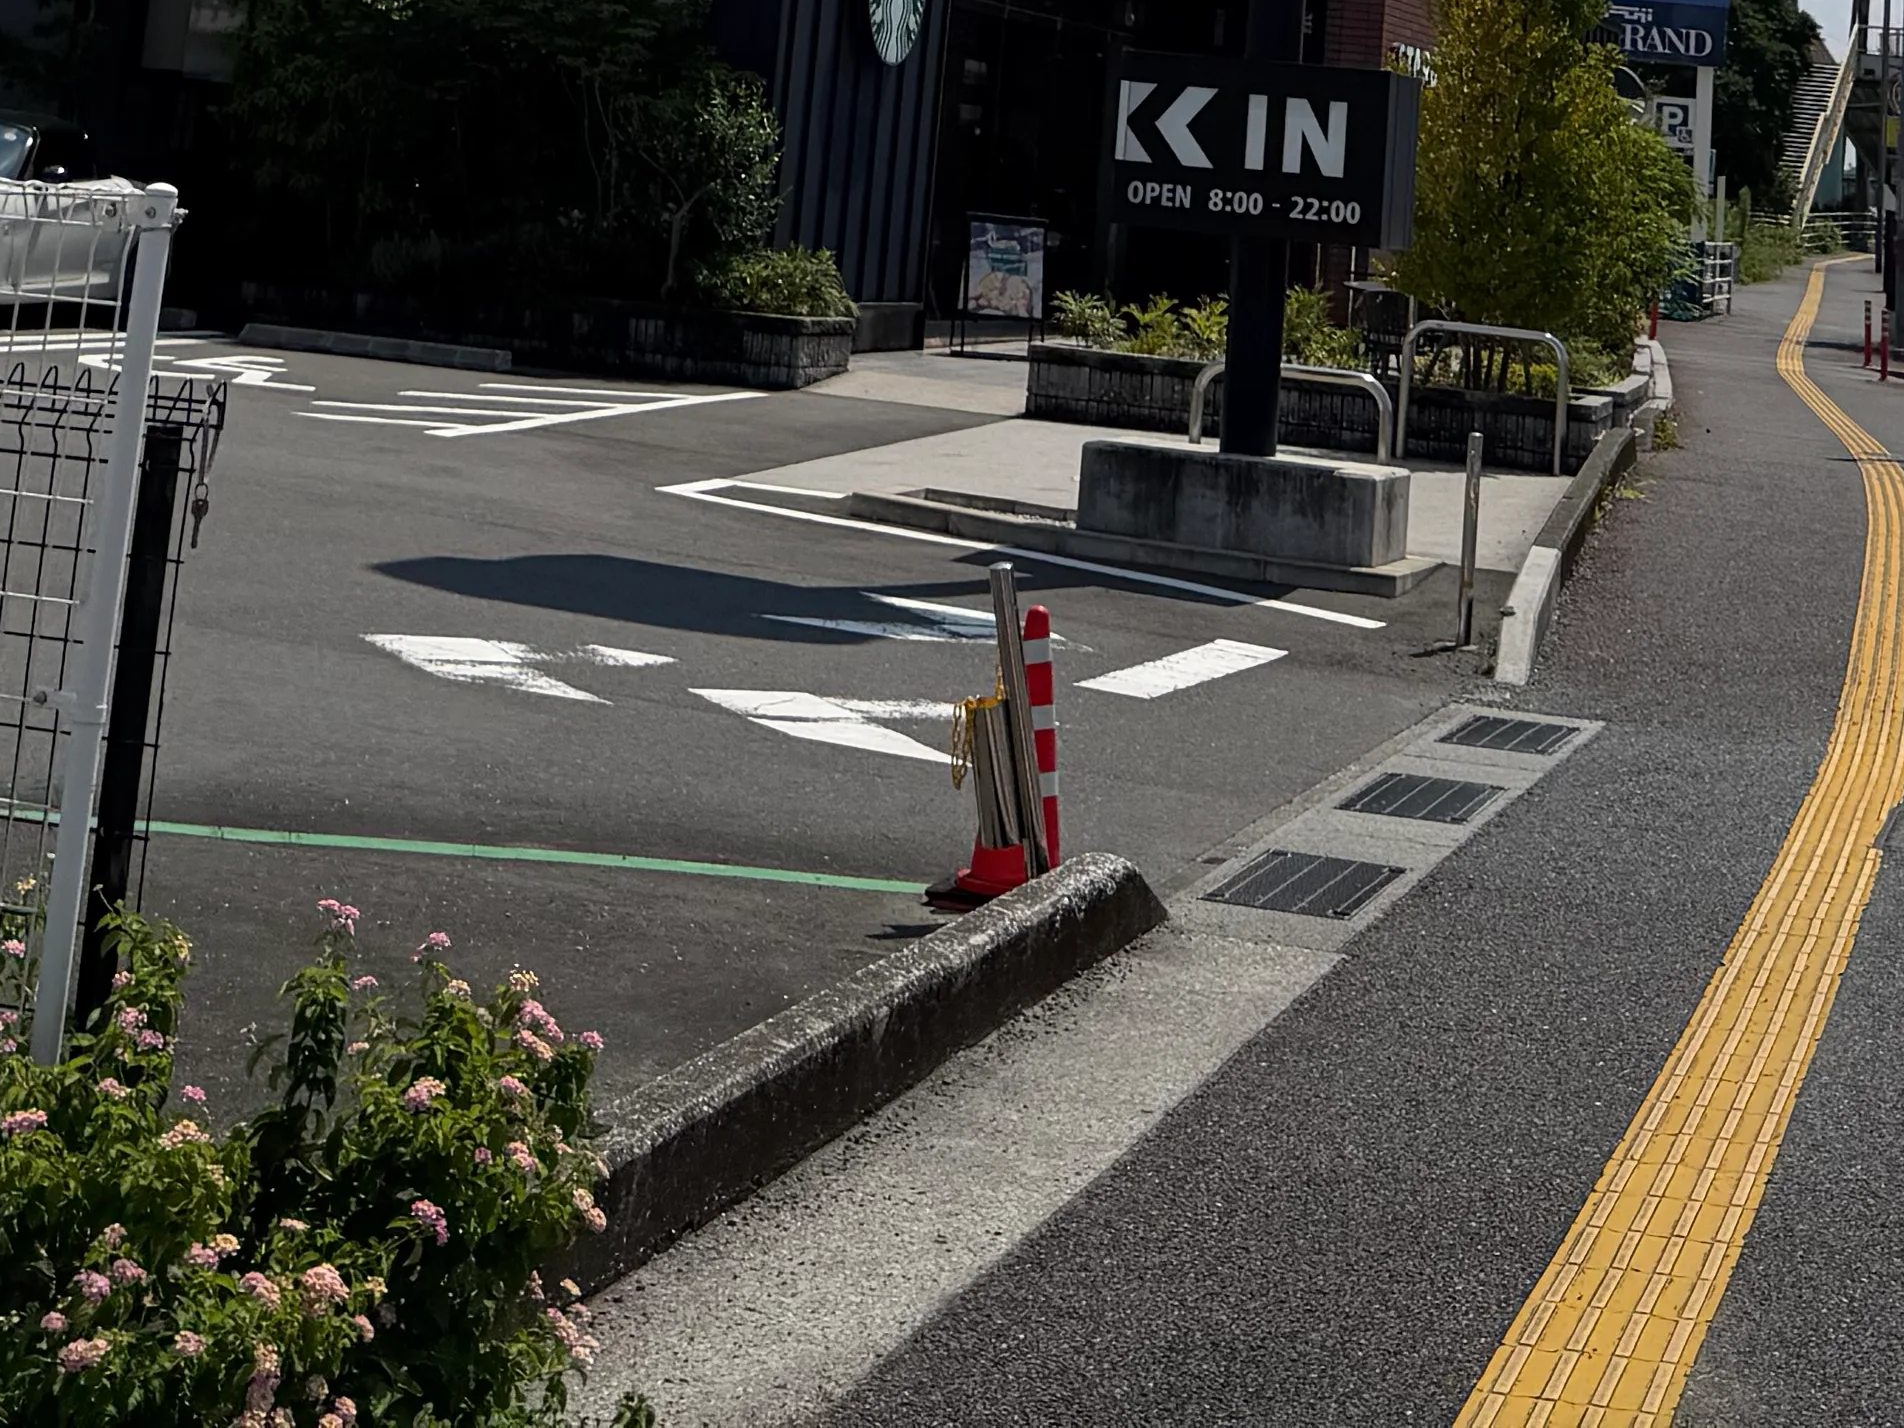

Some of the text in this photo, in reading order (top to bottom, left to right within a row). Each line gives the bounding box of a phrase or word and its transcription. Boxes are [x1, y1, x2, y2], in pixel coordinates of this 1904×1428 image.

[1620, 23, 1713, 57] RAND
[1244, 94, 1348, 178] IN
[1661, 106, 1684, 136] P
[1127, 180, 1191, 209] OPEN
[1208, 188, 1264, 216] 8:00
[1288, 195, 1361, 225] 22:00
